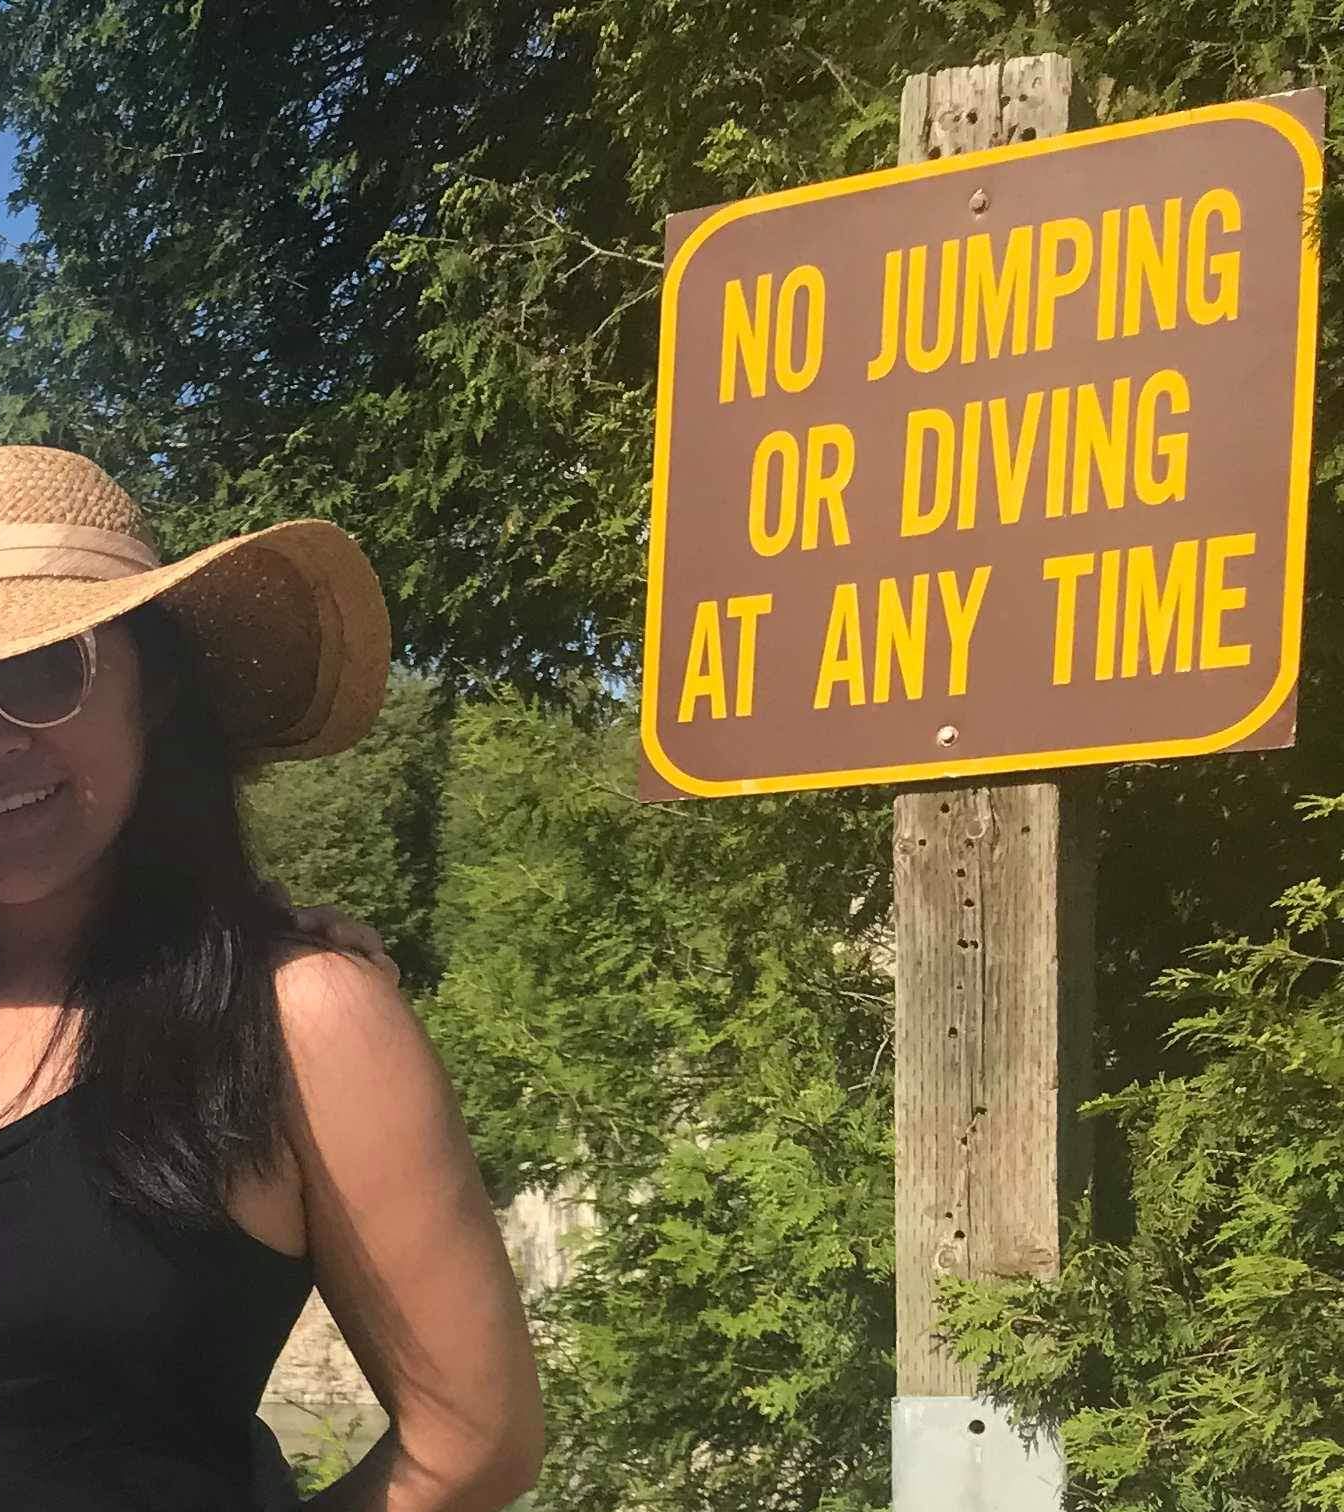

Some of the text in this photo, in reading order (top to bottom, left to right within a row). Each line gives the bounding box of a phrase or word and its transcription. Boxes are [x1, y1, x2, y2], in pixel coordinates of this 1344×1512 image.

[718, 188, 1242, 404] NO JUMPING
[748, 369, 1190, 557] OR DIVING
[676, 532, 1256, 723] AT ANY TIME
